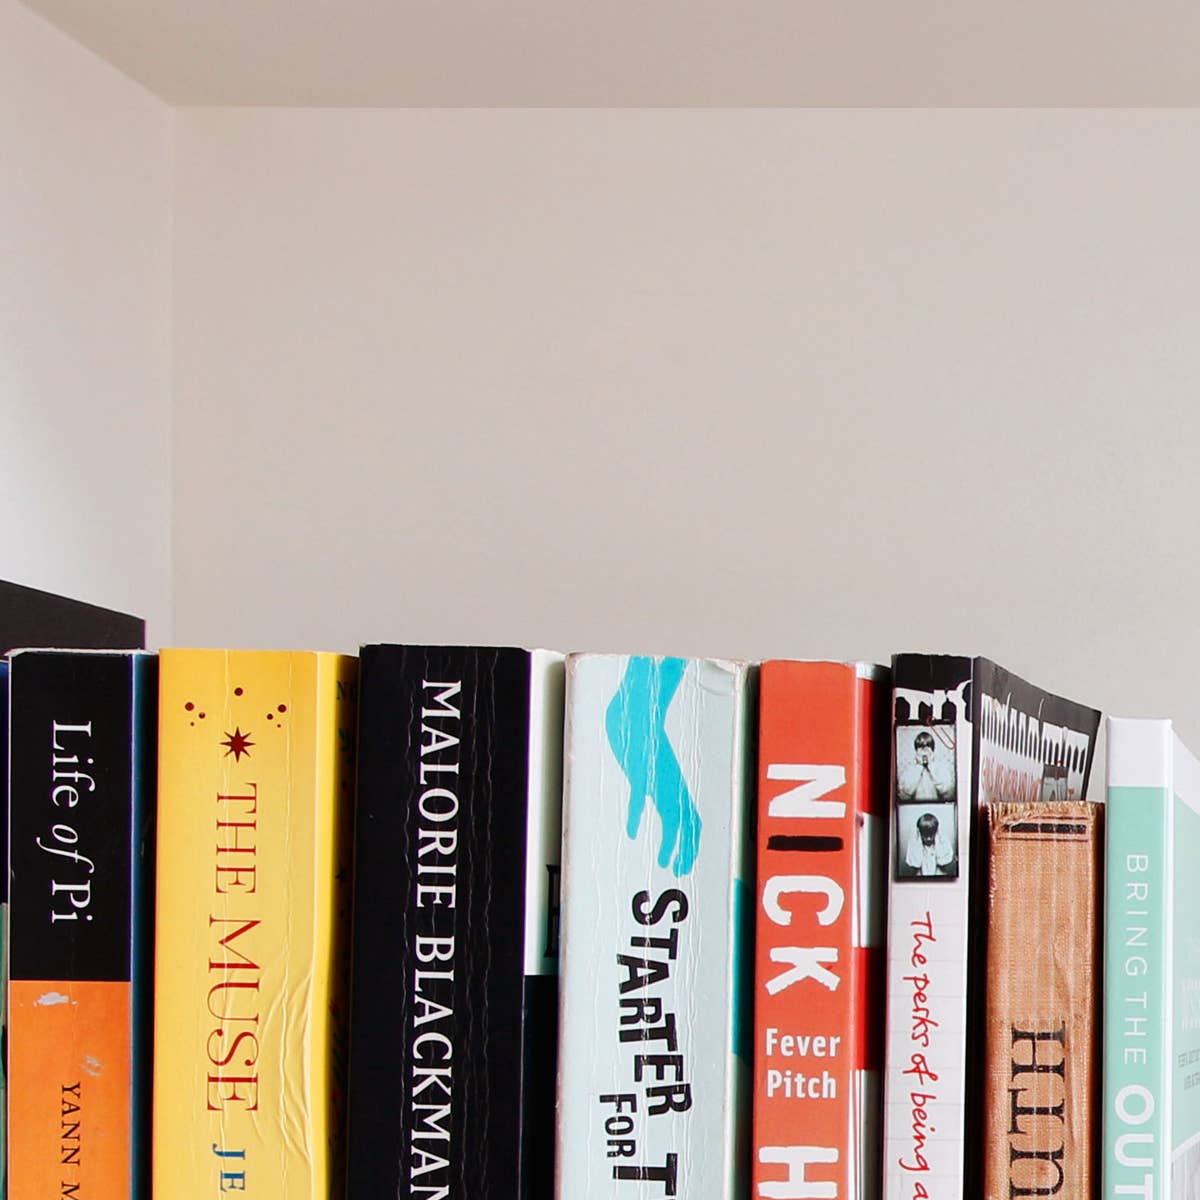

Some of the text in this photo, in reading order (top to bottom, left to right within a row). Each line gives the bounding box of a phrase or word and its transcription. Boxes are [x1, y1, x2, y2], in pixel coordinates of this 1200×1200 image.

[36, 720, 96, 924] Life of Pi
[416, 679, 462, 908] MALORIE
[762, 763, 847, 996] NICK
[1124, 854, 1150, 977] BRING
[207, 782, 261, 1111] THE MUSE
[910, 911, 936, 967] The
[616, 888, 693, 1117] STARTER
[766, 1027, 841, 1058] Fever
[902, 973, 939, 1048] perks
[1123, 991, 1148, 1065] THE
[767, 1069, 837, 1099] Pitch
[902, 1053, 939, 1086] of
[61, 1082, 82, 1167] YANN
[599, 1093, 637, 1159] FOR
[898, 1092, 937, 1172] being
